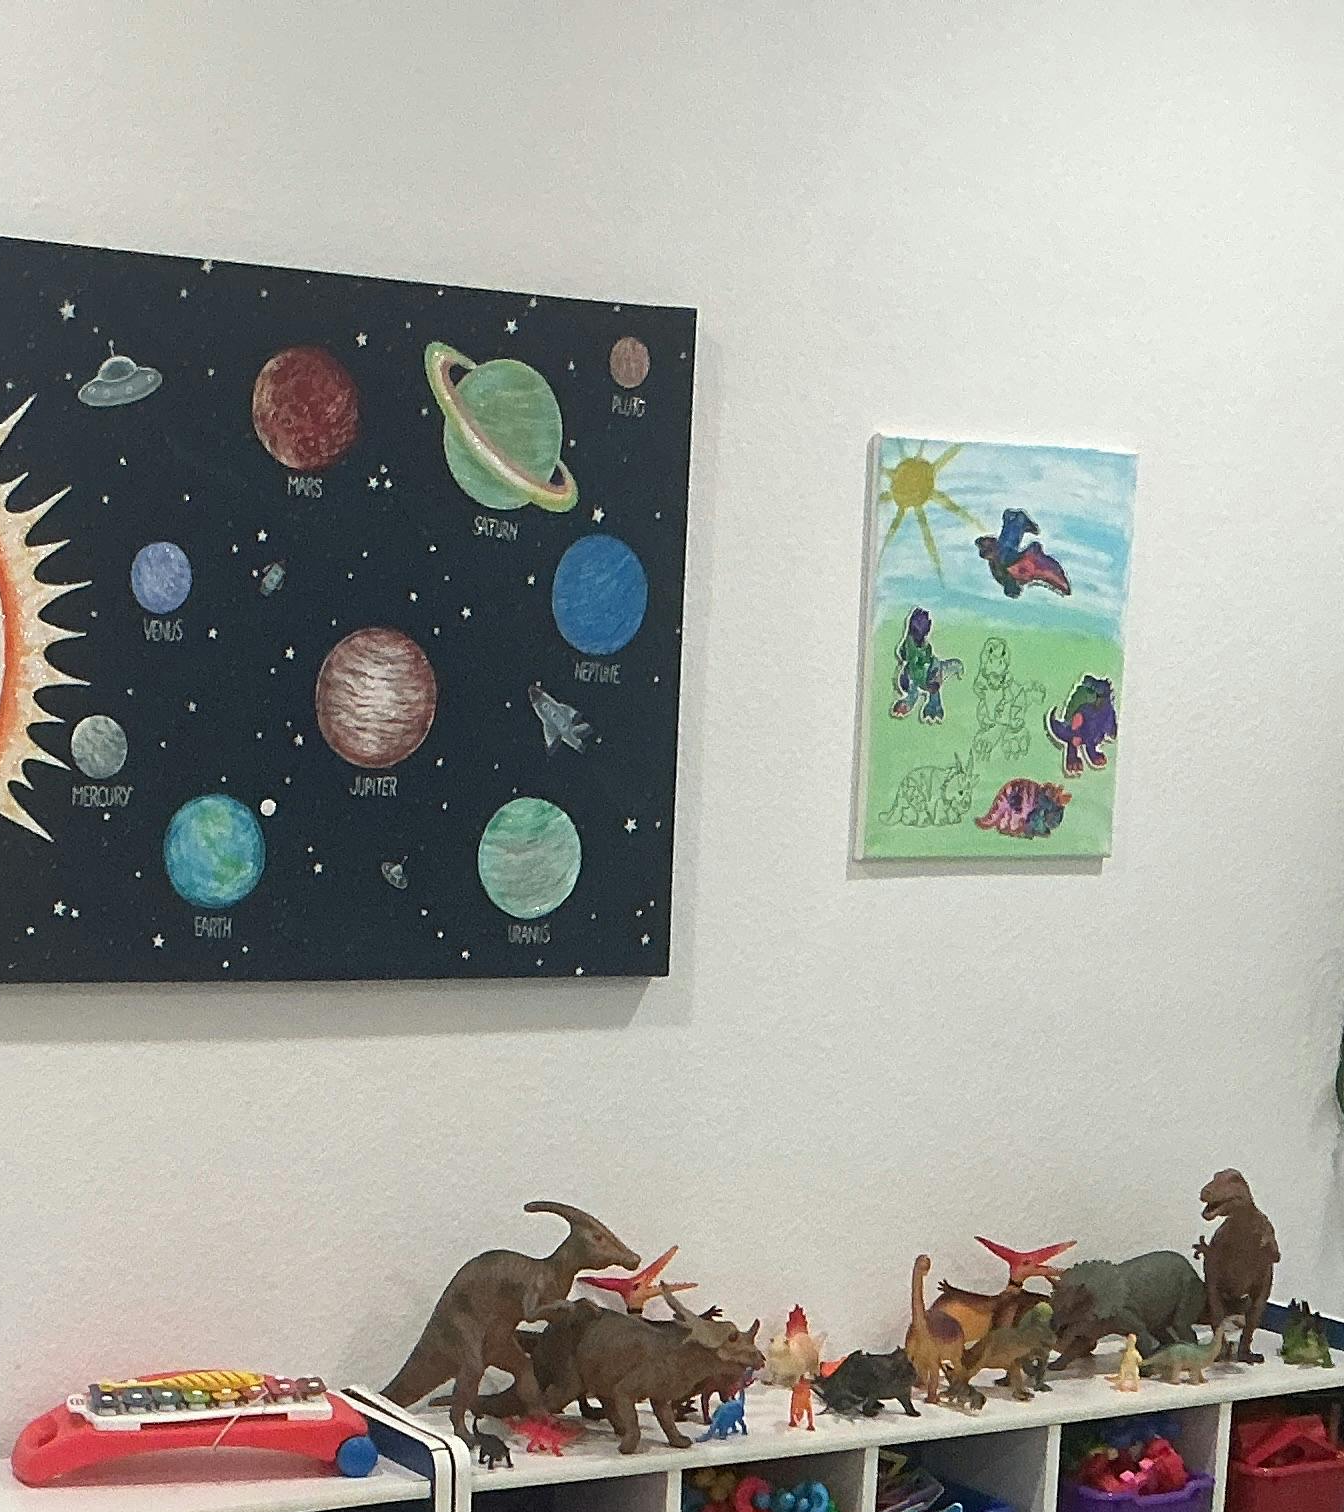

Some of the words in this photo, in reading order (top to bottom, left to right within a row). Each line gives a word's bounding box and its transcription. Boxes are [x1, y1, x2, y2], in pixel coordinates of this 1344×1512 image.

[286, 475, 324, 498] MARS
[472, 515, 520, 541] SATURN
[142, 618, 184, 642] VENUS
[574, 661, 623, 684] NEPTUNE
[71, 784, 135, 808] MERCURY
[349, 775, 398, 798] JUPITER
[194, 915, 233, 938] EARTH
[507, 923, 552, 945] URANUS
